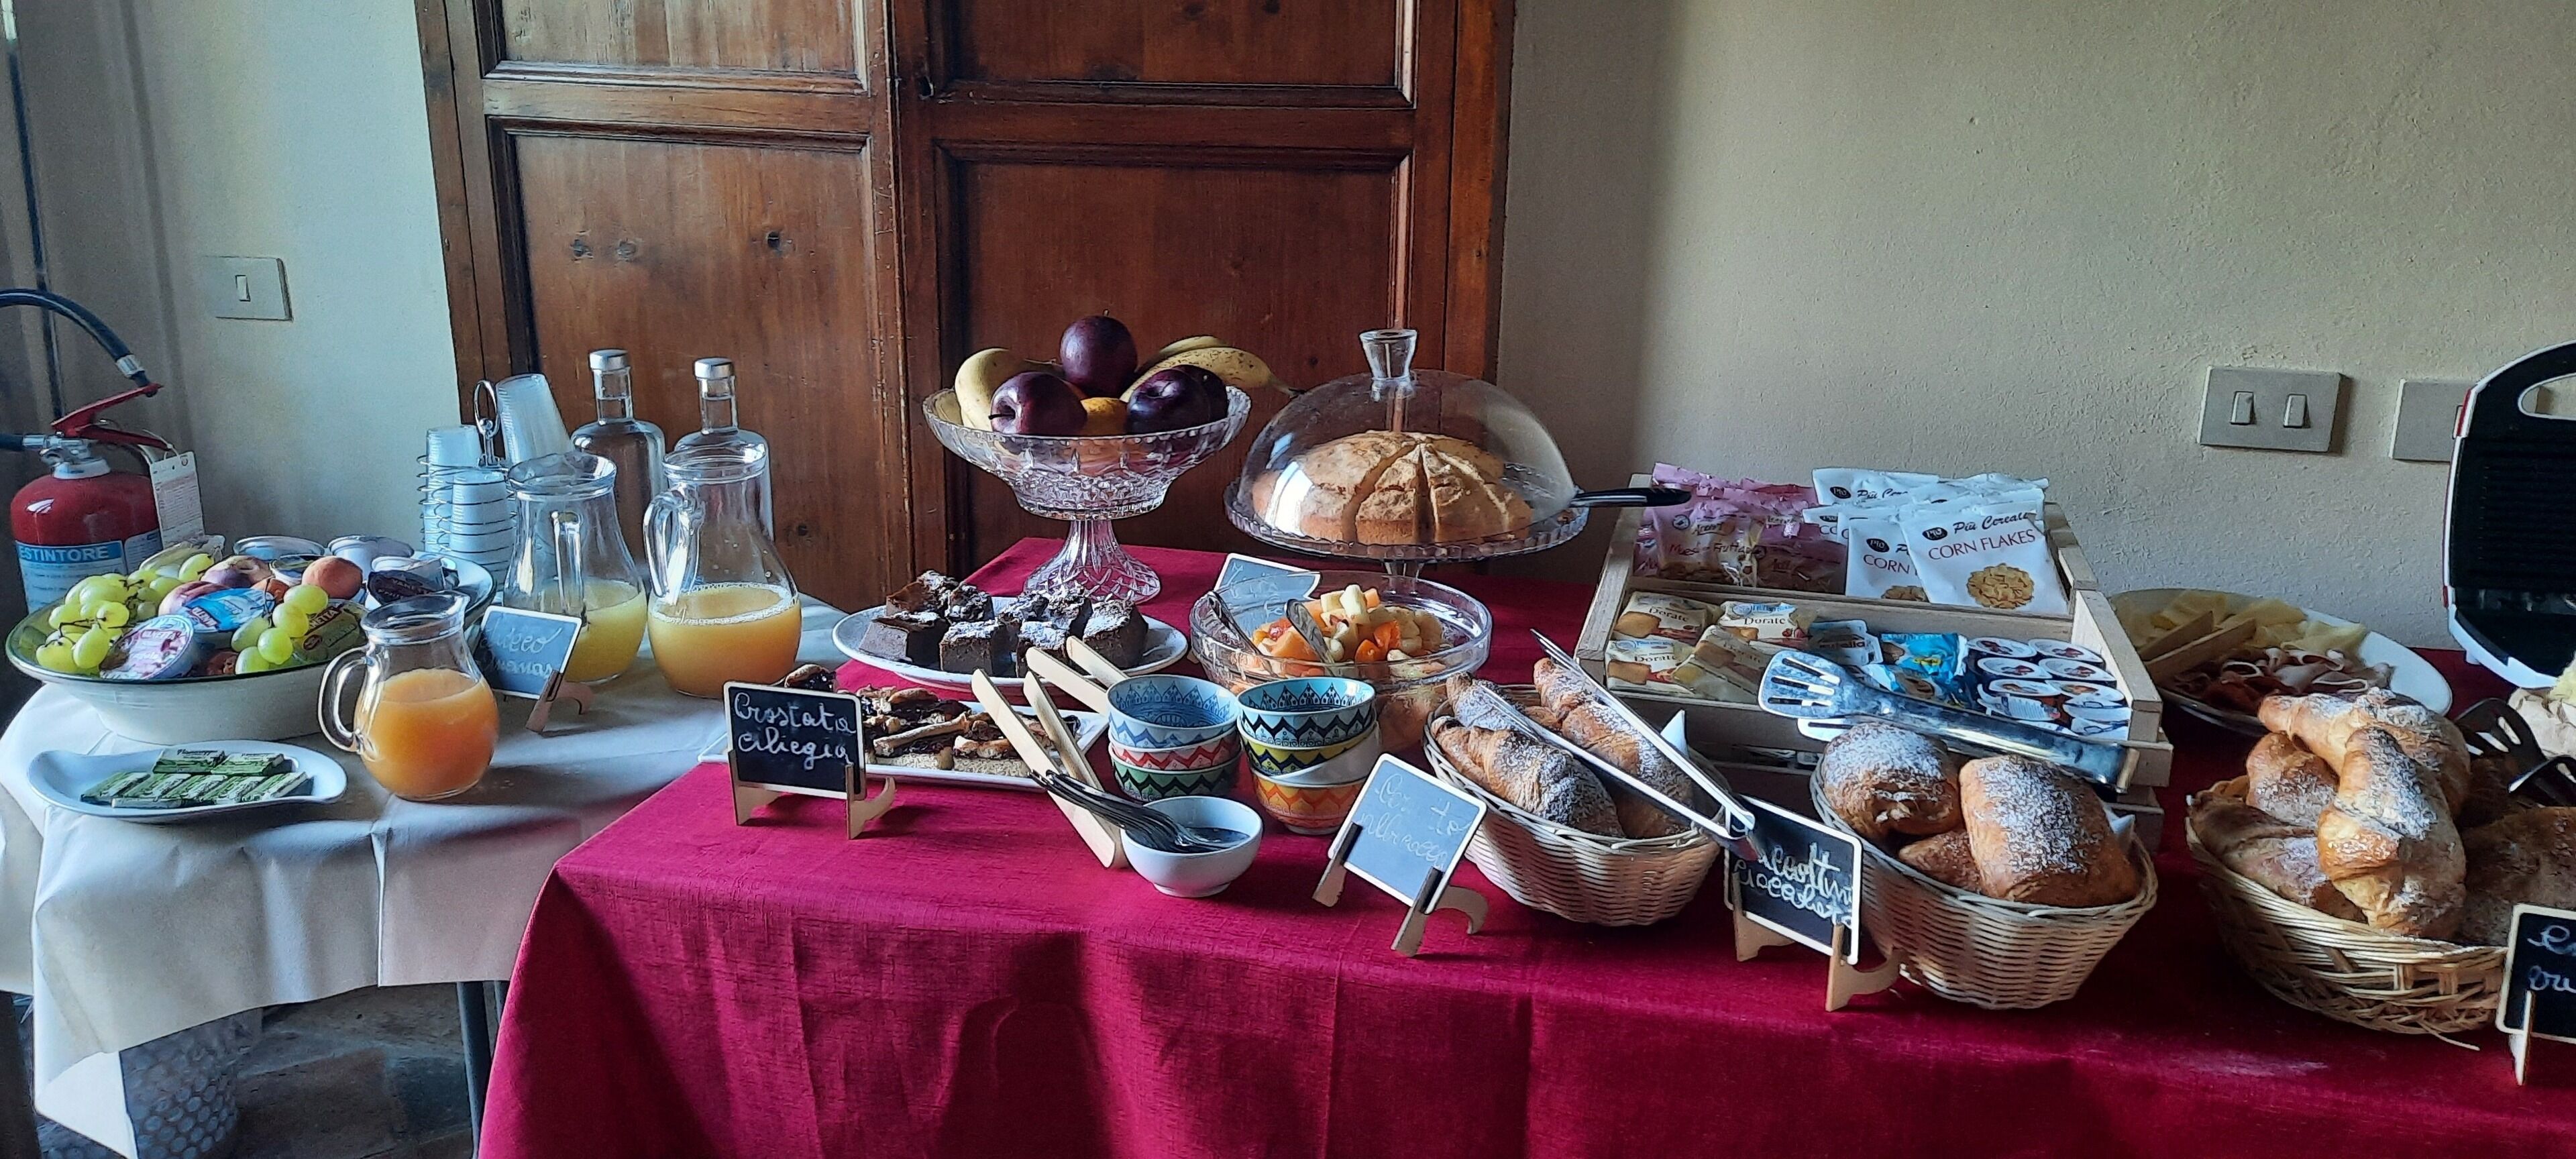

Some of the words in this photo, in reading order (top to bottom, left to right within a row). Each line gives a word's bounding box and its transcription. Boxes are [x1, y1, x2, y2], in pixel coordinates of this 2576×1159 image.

[1953, 522, 1978, 534] Più
[1928, 540, 1978, 560] CORN
[1980, 529, 2036, 551] FLAKES
[19, 545, 109, 561] ESTINTORE
[1863, 554, 1911, 575] CORN
[1648, 606, 1689, 622] Dorate
[1744, 616, 1786, 626] Dorate
[734, 692, 856, 734] Crostata
